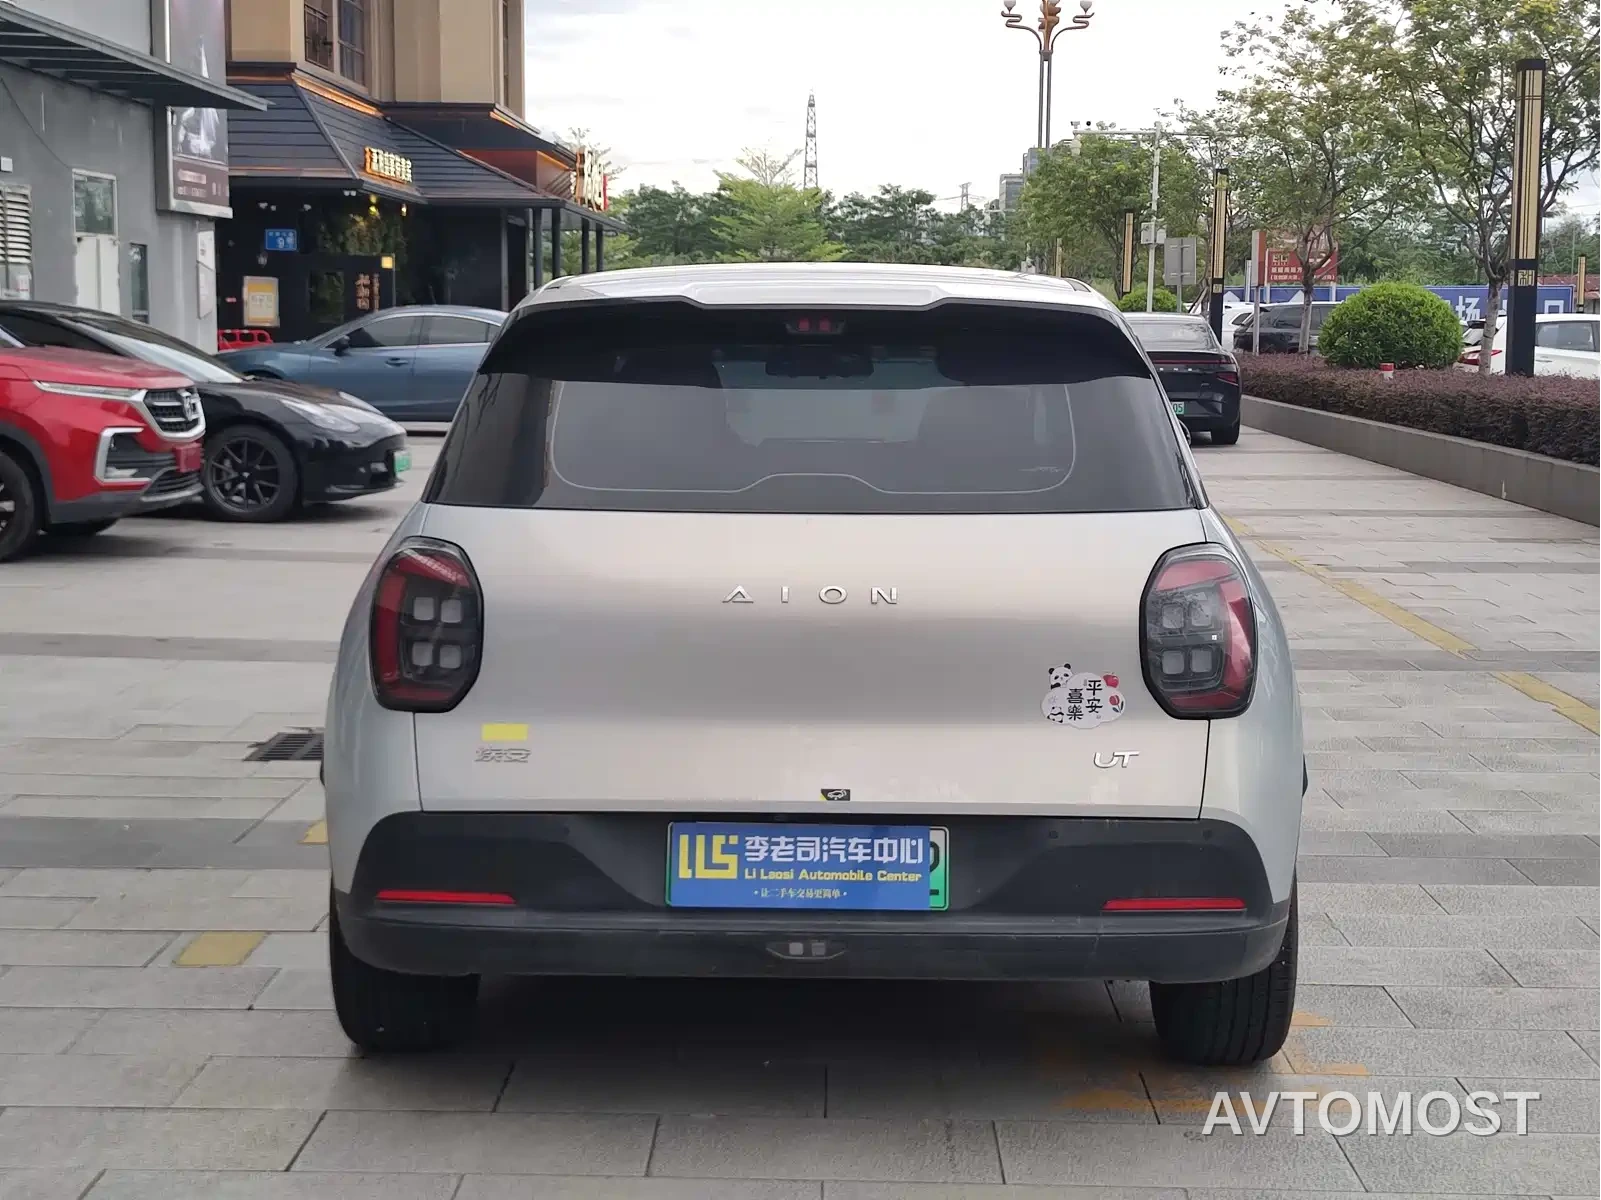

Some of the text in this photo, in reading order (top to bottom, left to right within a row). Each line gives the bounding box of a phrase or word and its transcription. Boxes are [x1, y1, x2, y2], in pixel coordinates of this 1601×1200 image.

[722, 585, 898, 605] AION
[1085, 679, 1104, 714] 平安
[1093, 750, 1141, 769] UT
[744, 835, 924, 865] 李老司汽车中心
[744, 868, 922, 882] Li Laosi Automobile Center
